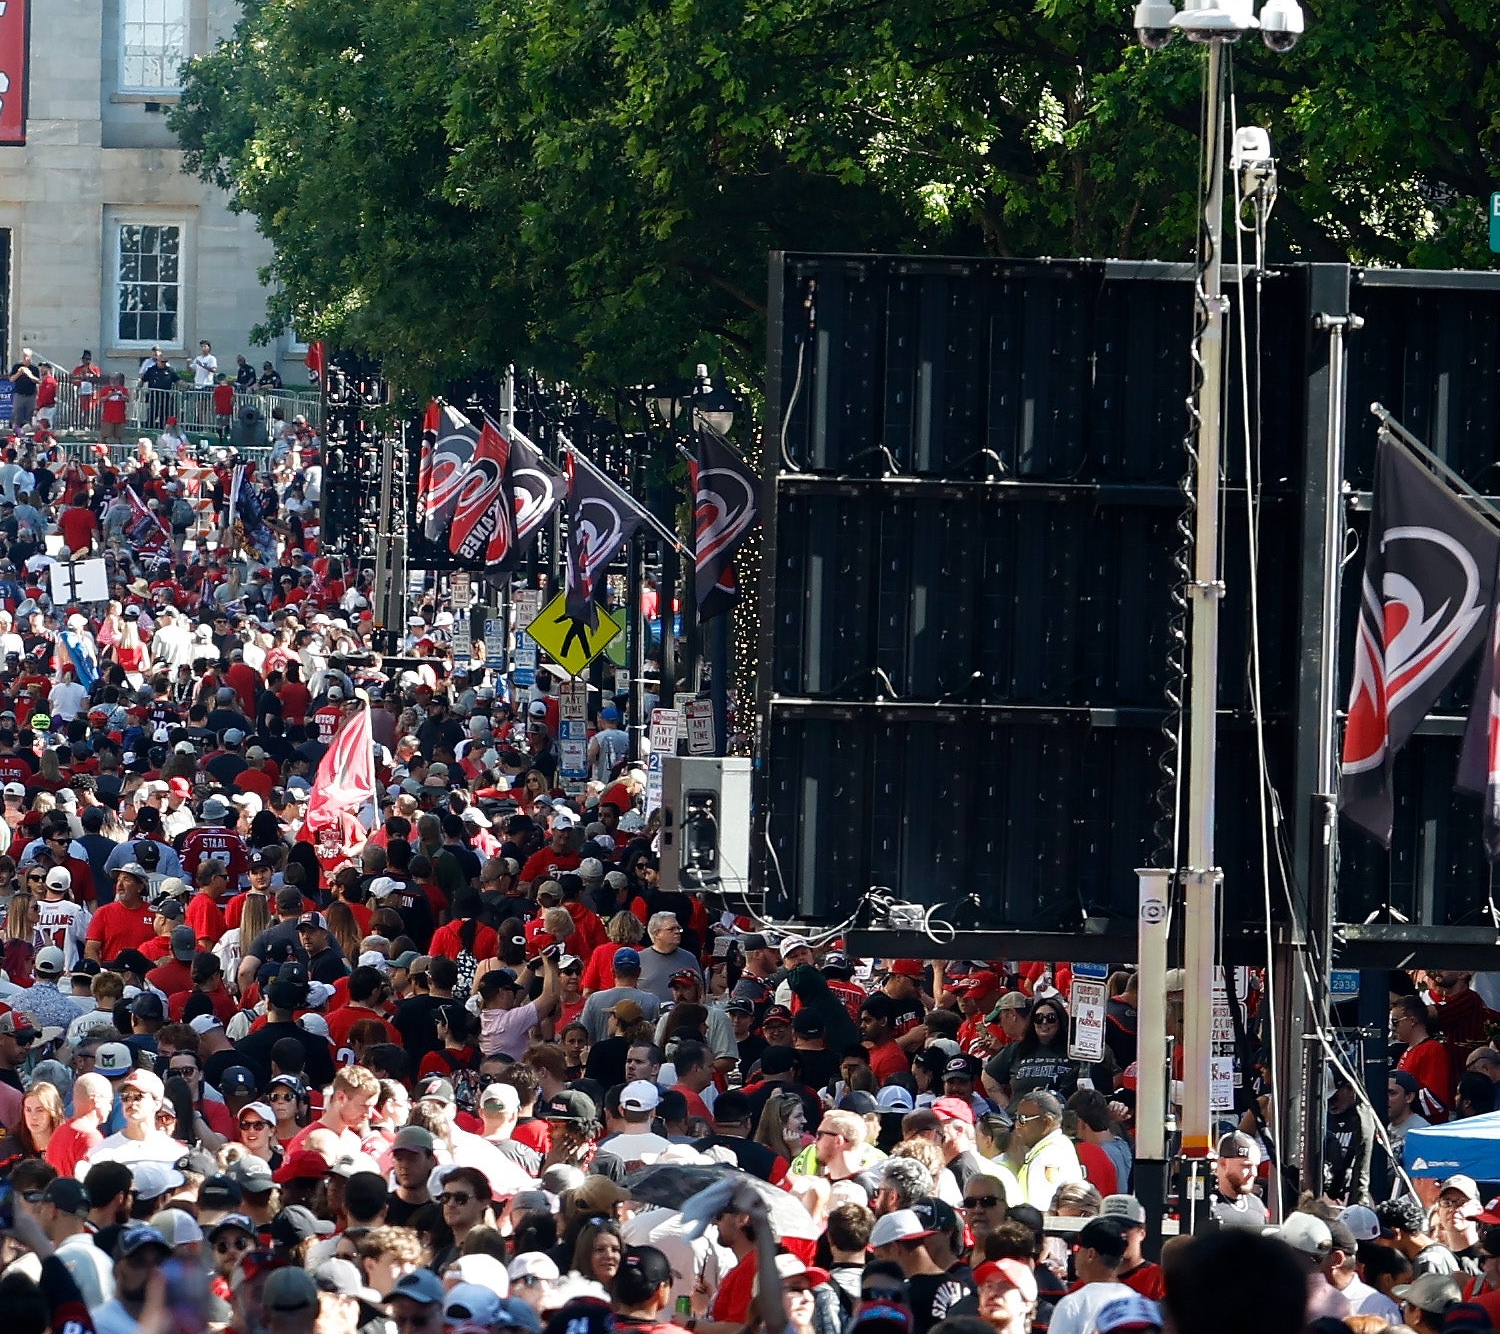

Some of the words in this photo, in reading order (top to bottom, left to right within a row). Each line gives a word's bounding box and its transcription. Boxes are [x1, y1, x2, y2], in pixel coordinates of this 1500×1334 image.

[565, 696, 582, 704] ANY
[565, 705, 582, 715] TIME
[694, 719, 706, 728] ANY
[562, 725, 567, 737] 2
[655, 727, 672, 735] ANY
[694, 730, 708, 740] TIME
[654, 737, 674, 747] TIME
[651, 755, 658, 767] 2
[202, 837, 228, 847] STAAL
[1078, 1018, 1101, 1028] PARKING
